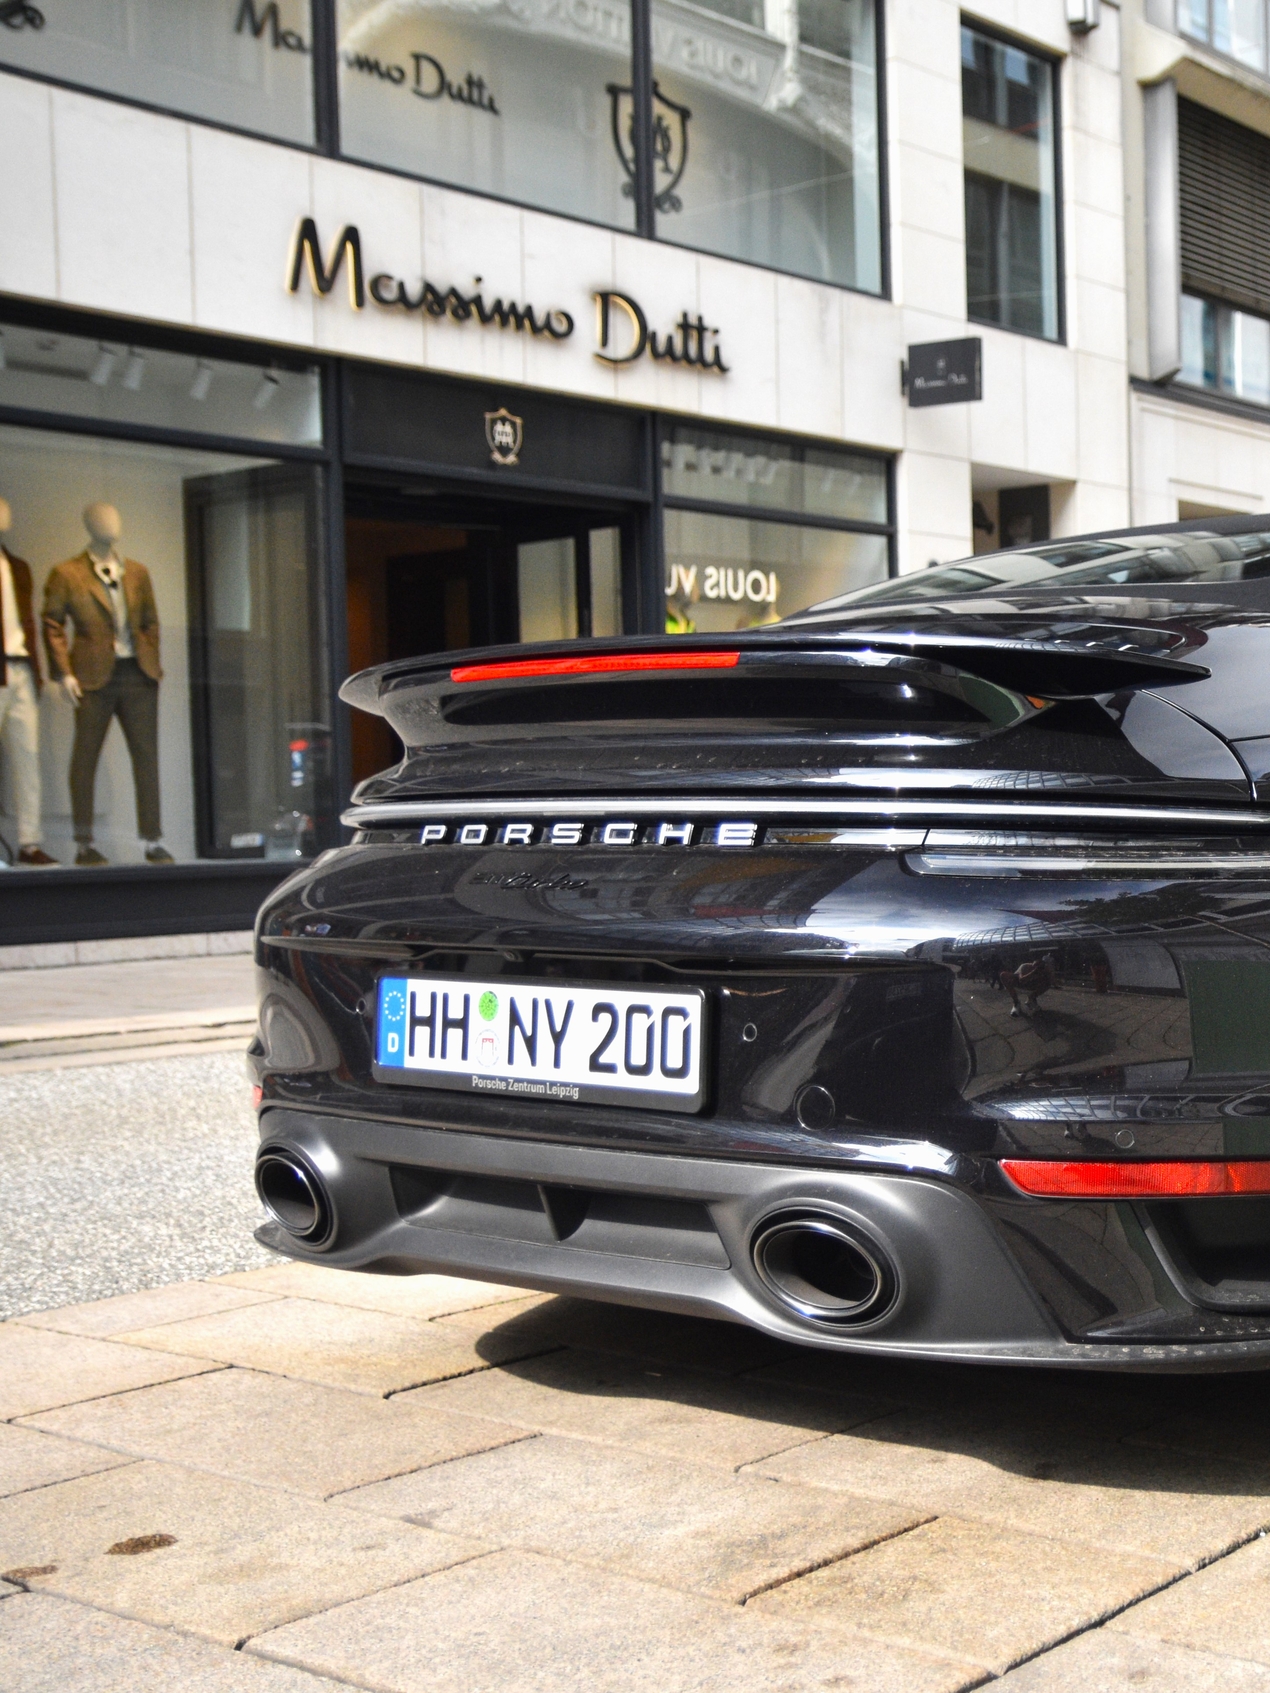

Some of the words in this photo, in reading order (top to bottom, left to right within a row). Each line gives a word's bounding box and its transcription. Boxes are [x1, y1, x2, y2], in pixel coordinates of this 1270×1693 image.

[410, 53, 500, 116] Dutti
[285, 217, 575, 340] Massimo
[592, 290, 730, 374] Dutti
[421, 823, 757, 847] PORSCHE
[387, 1032, 399, 1053] D
[409, 990, 471, 1062] HH
[508, 996, 575, 1070] NY
[589, 1002, 692, 1080] 200
[472, 1075, 507, 1090] Porsche
[508, 1078, 545, 1094] Zentrum
[546, 1082, 579, 1100] Leipzig
